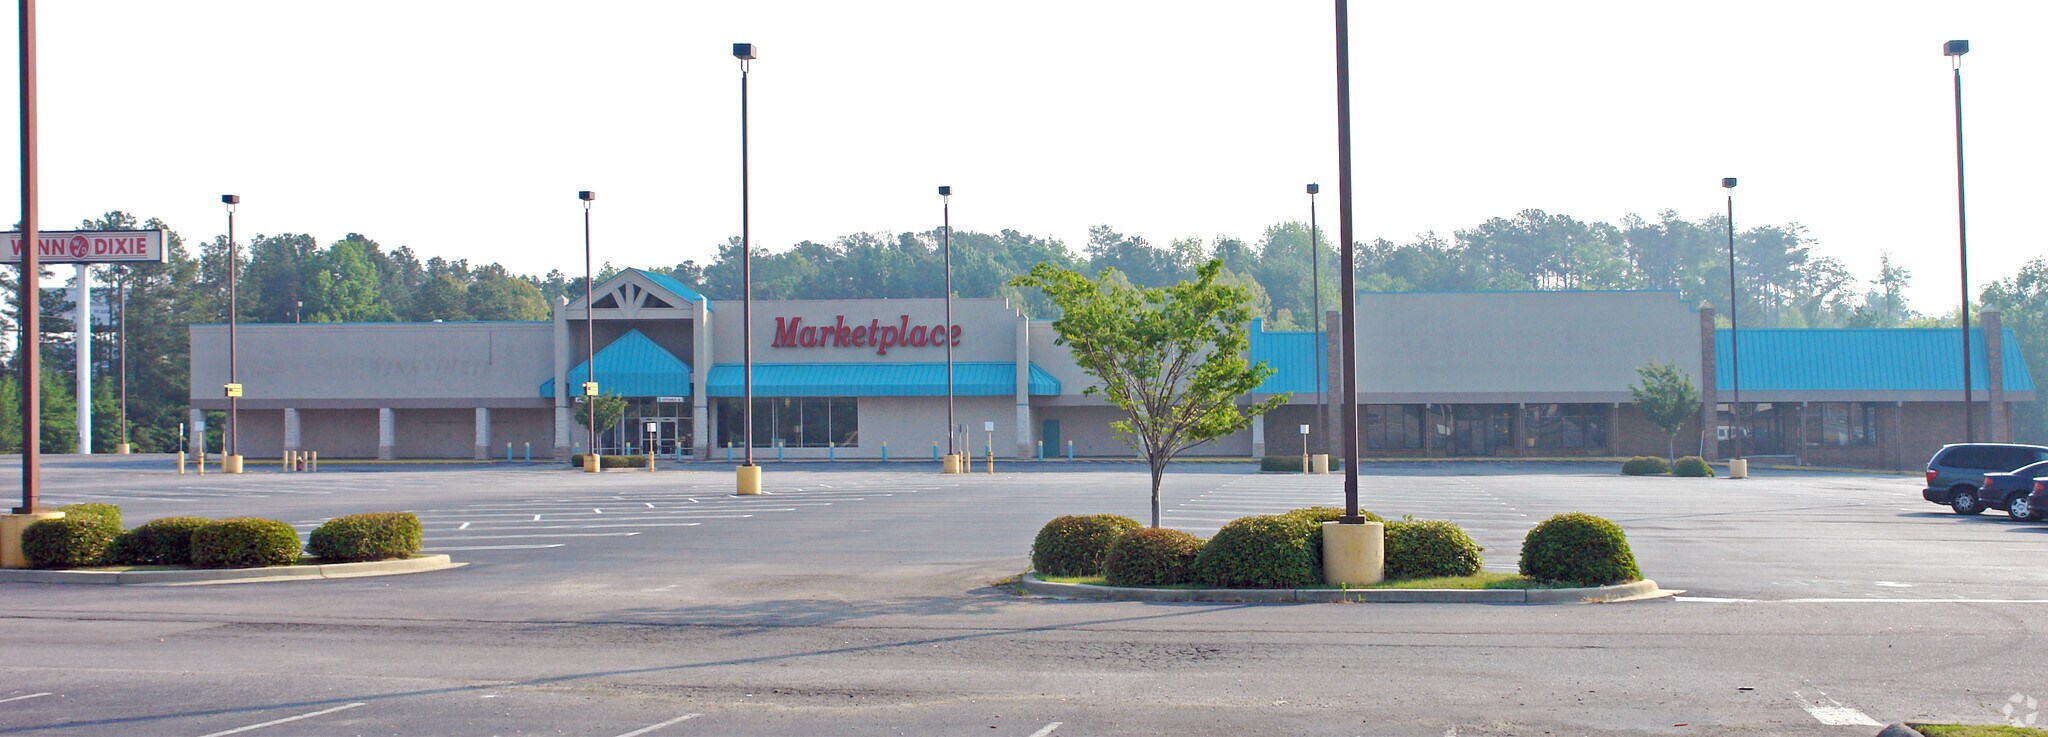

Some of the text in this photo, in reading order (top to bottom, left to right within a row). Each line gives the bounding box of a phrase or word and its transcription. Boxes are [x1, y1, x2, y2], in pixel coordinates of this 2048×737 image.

[11, 239, 65, 255] WNN
[95, 238, 146, 254] DIXIE
[771, 315, 962, 355] Marketplace
